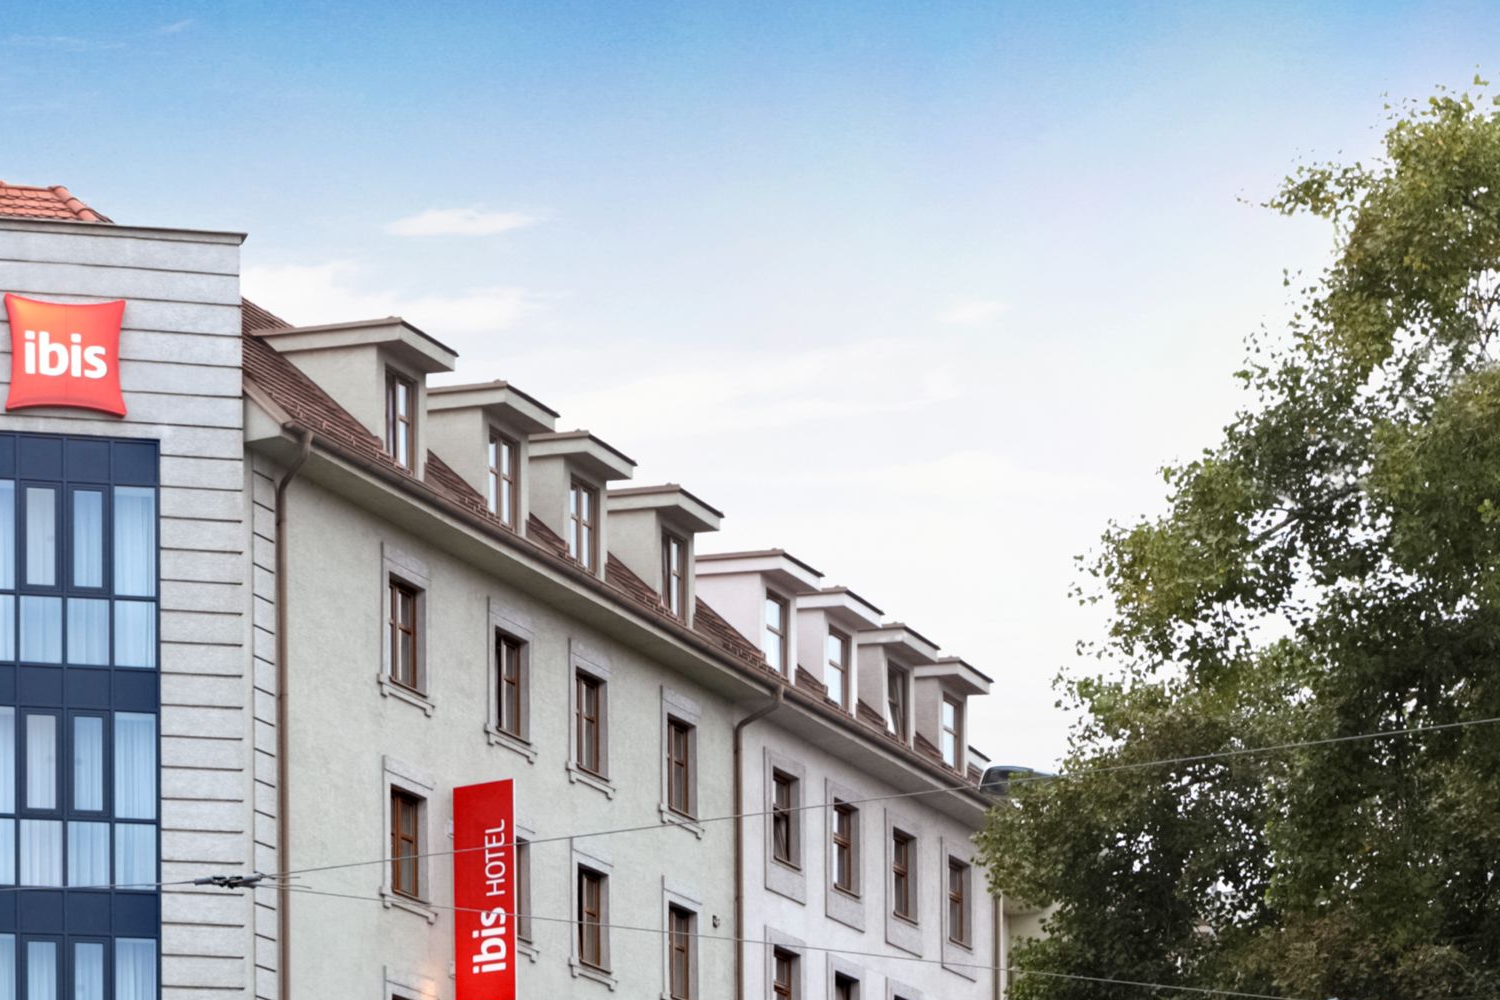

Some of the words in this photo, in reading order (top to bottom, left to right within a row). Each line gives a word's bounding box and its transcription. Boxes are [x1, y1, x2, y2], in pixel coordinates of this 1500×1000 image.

[24, 330, 108, 379] ibis
[485, 819, 506, 897] HOTEL
[472, 907, 507, 974] ibis
